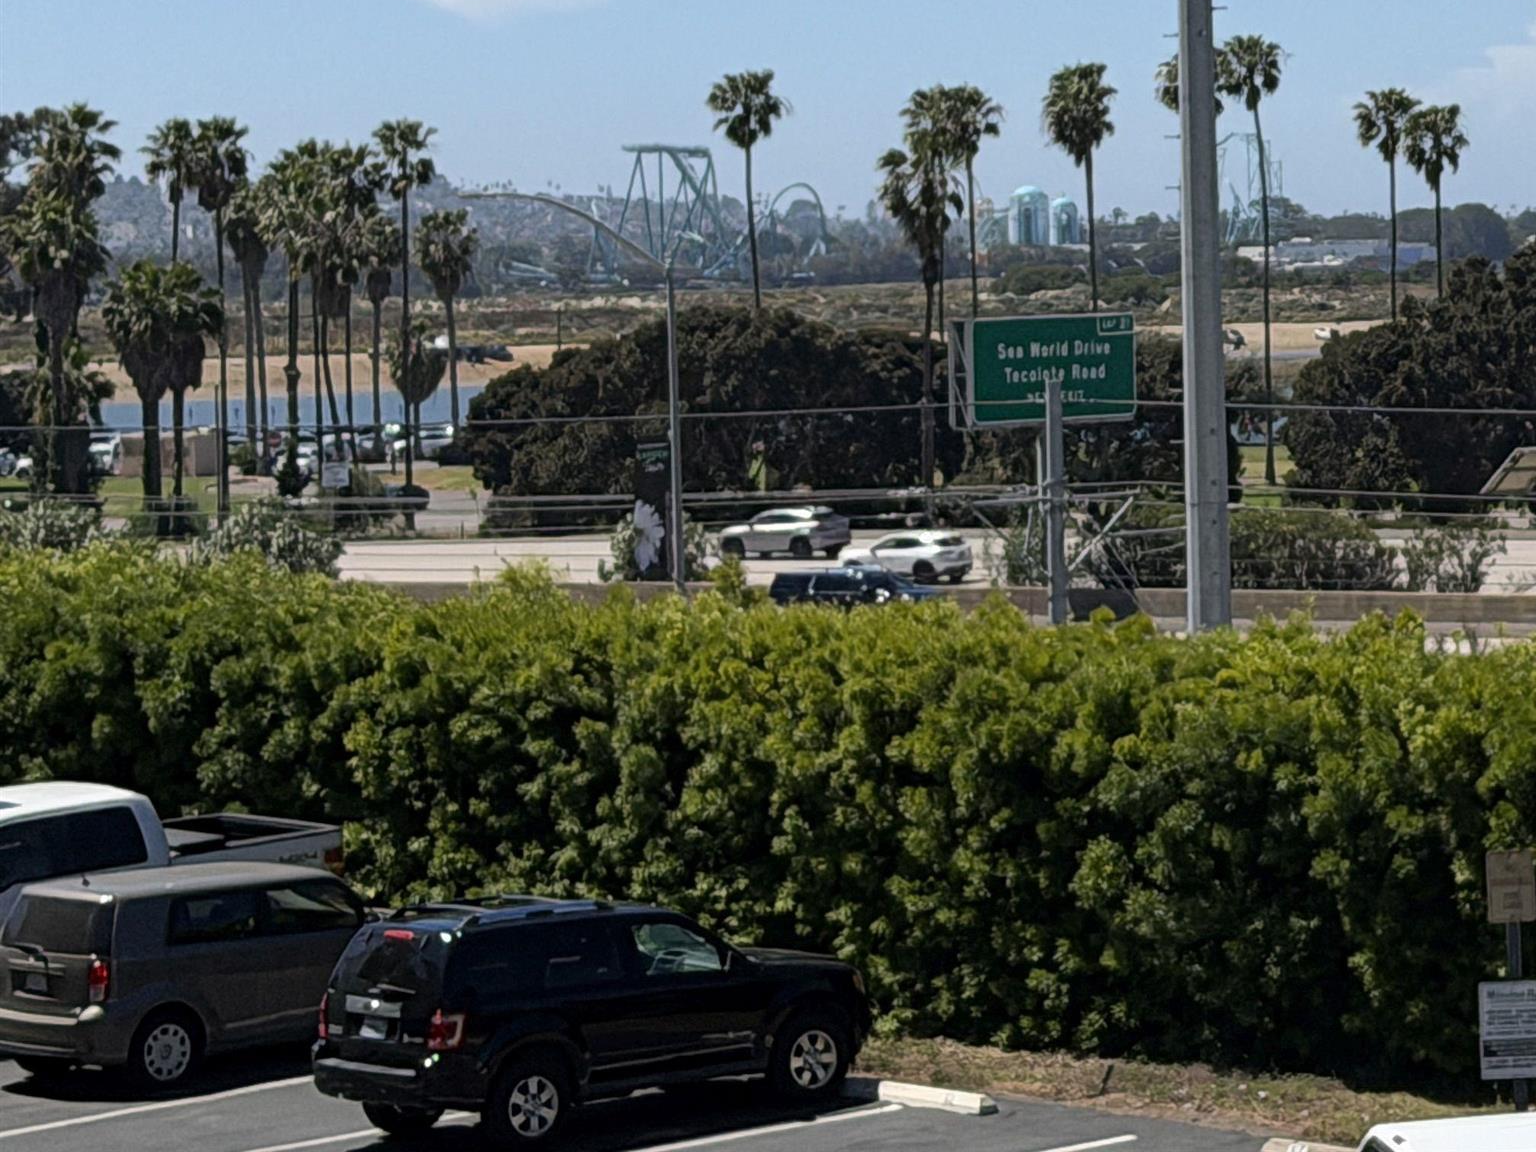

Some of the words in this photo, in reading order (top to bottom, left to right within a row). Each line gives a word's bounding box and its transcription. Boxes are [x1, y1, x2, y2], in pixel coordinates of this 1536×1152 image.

[997, 342, 1024, 359] Sea
[1030, 340, 1068, 358] World
[1074, 339, 1111, 356] Drive
[1004, 366, 1065, 383] Tecolote
[1071, 363, 1106, 380] Road
